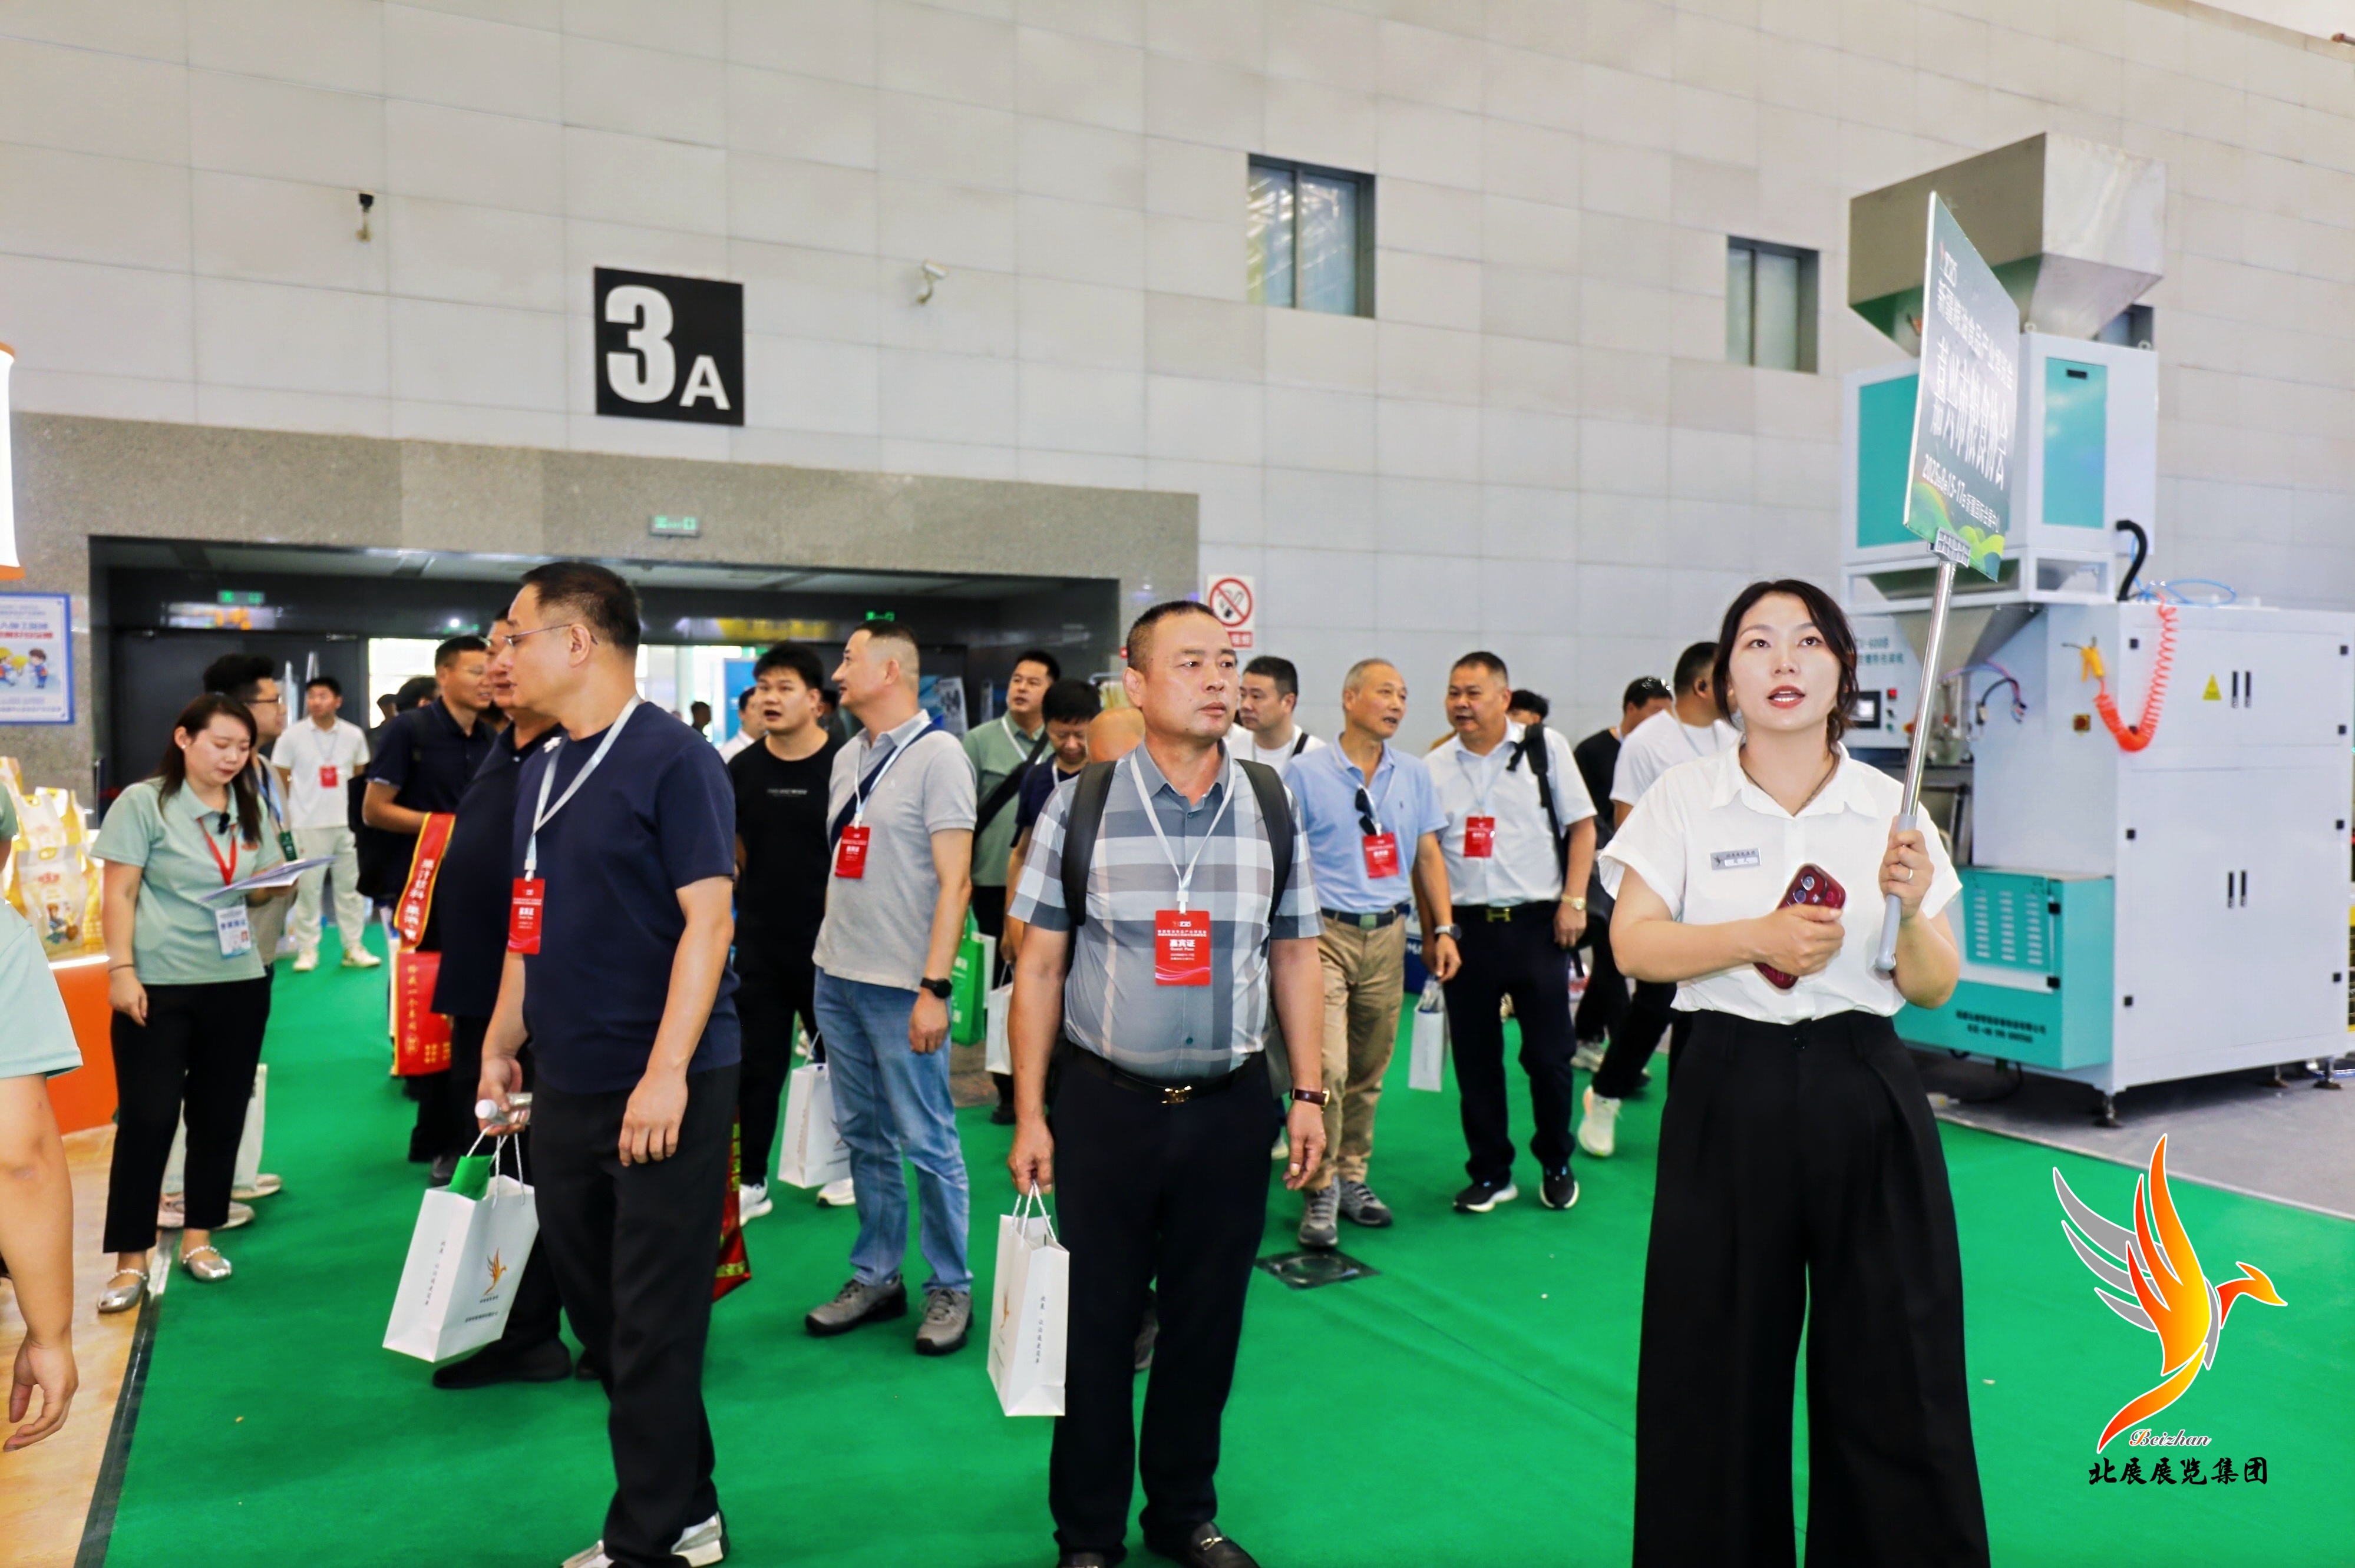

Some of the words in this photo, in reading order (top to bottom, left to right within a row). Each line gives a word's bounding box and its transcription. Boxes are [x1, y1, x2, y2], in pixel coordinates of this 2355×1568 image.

[605, 284, 731, 411] 3A
[1937, 278, 2013, 391] 新疆粮油食品产业博览会
[1930, 335, 2010, 491] 嘉兴市粮食协会
